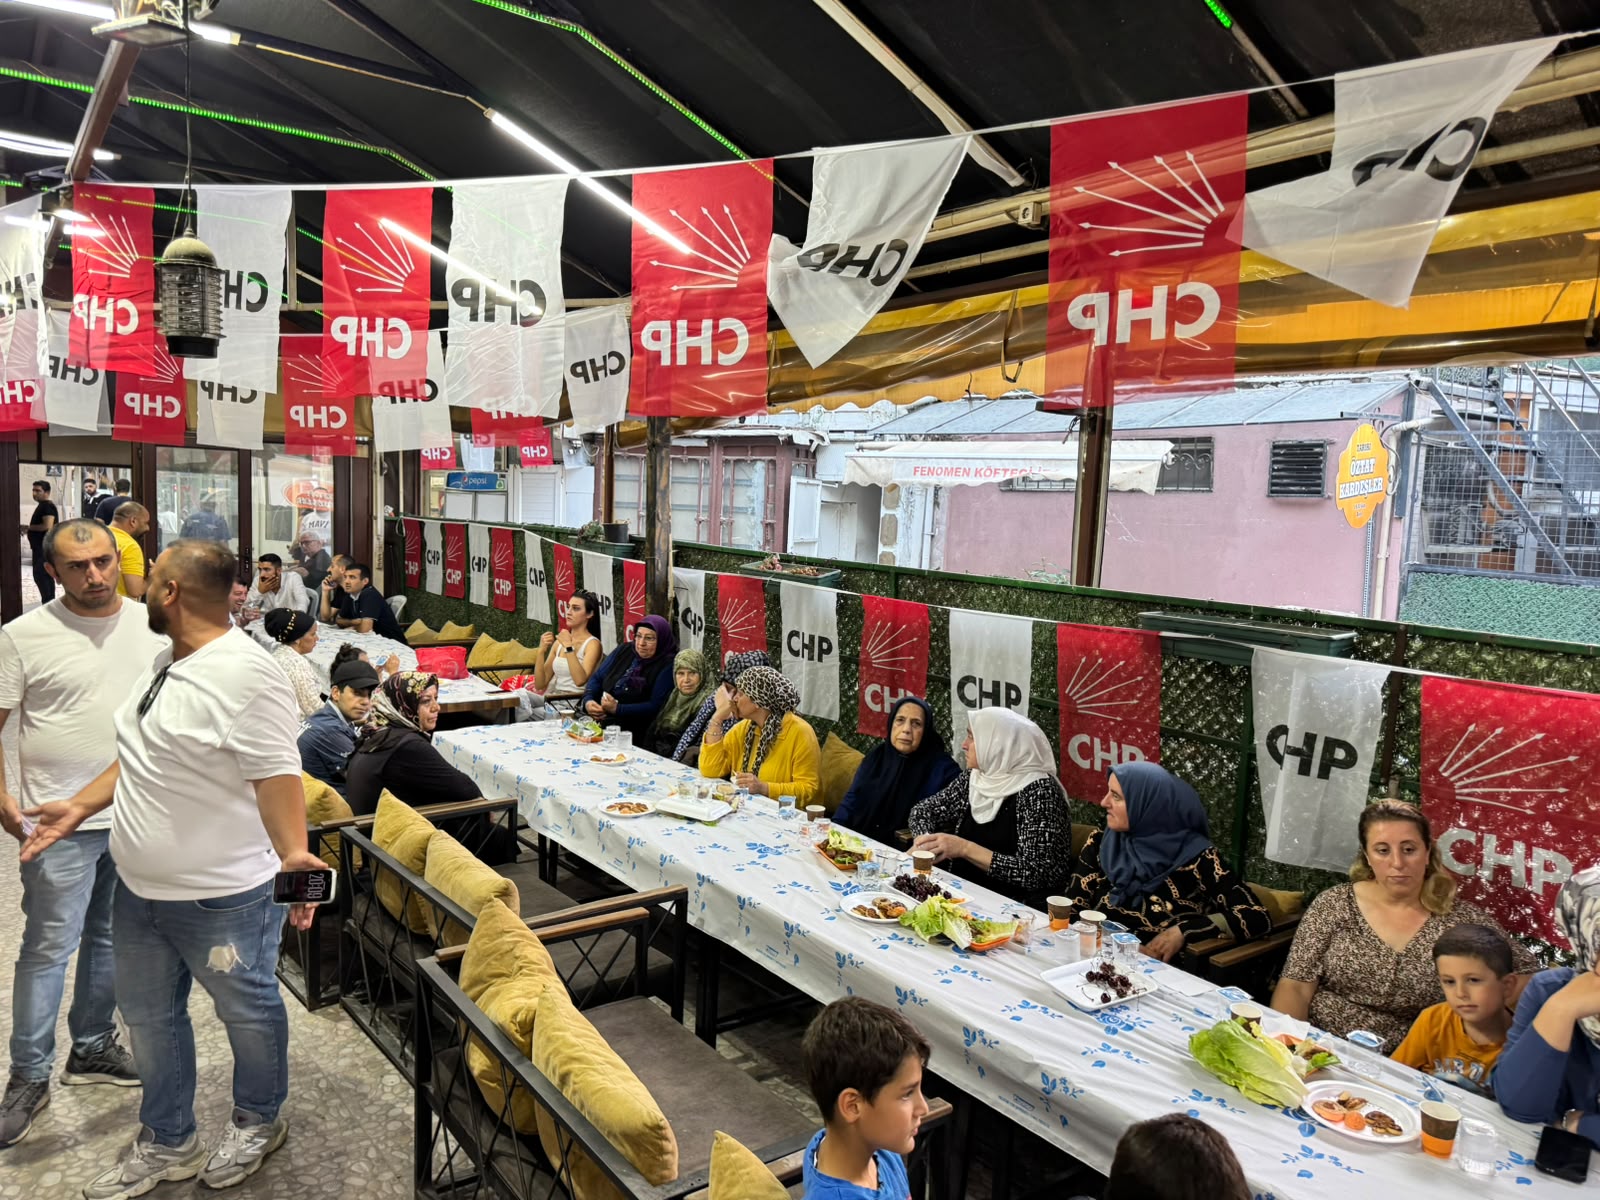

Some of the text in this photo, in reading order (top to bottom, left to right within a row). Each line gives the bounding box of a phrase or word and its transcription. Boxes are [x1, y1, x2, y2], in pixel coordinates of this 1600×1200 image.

[912, 465, 971, 478] FENOMEN
[1350, 457, 1375, 476] ÖZTAT
[1339, 478, 1383, 499] KARDEŞLER
[426, 549, 441, 566] CHP
[445, 568, 462, 585] CHP
[494, 577, 513, 597] CHP
[786, 629, 833, 664] CHP
[864, 683, 918, 714] CH
[956, 674, 1022, 710] CHP
[1266, 723, 1358, 781] CHP
[1436, 828, 1574, 896] CHP
